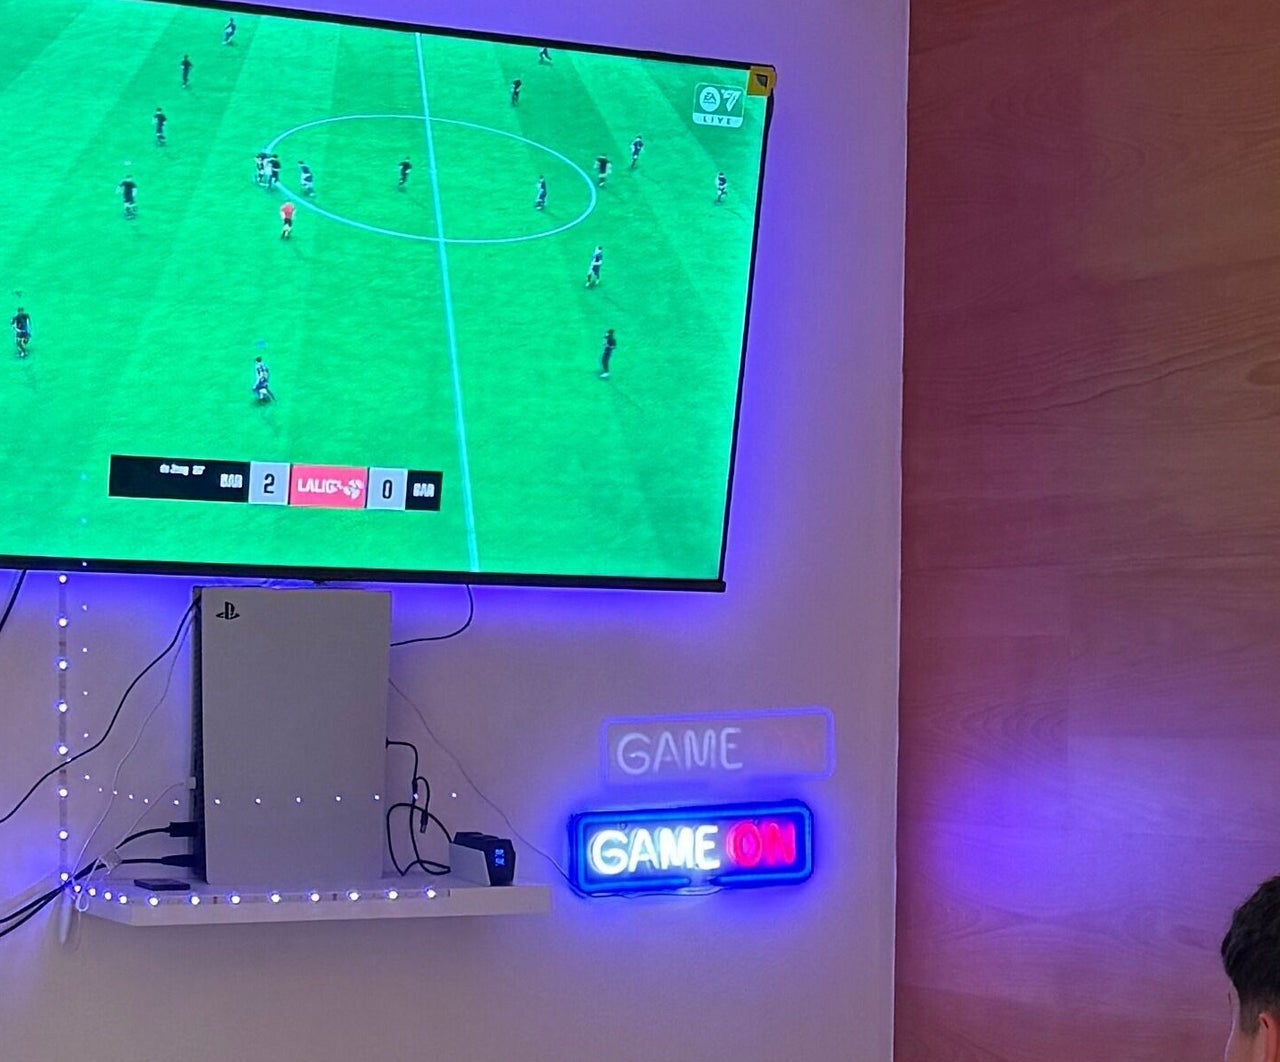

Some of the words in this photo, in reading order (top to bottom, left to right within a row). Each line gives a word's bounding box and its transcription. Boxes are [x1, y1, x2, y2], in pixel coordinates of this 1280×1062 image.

[263, 473, 275, 494] 2
[382, 479, 393, 500] 0
[615, 726, 743, 775] GAME
[588, 824, 721, 875] GAME
[726, 818, 798, 868] ON
